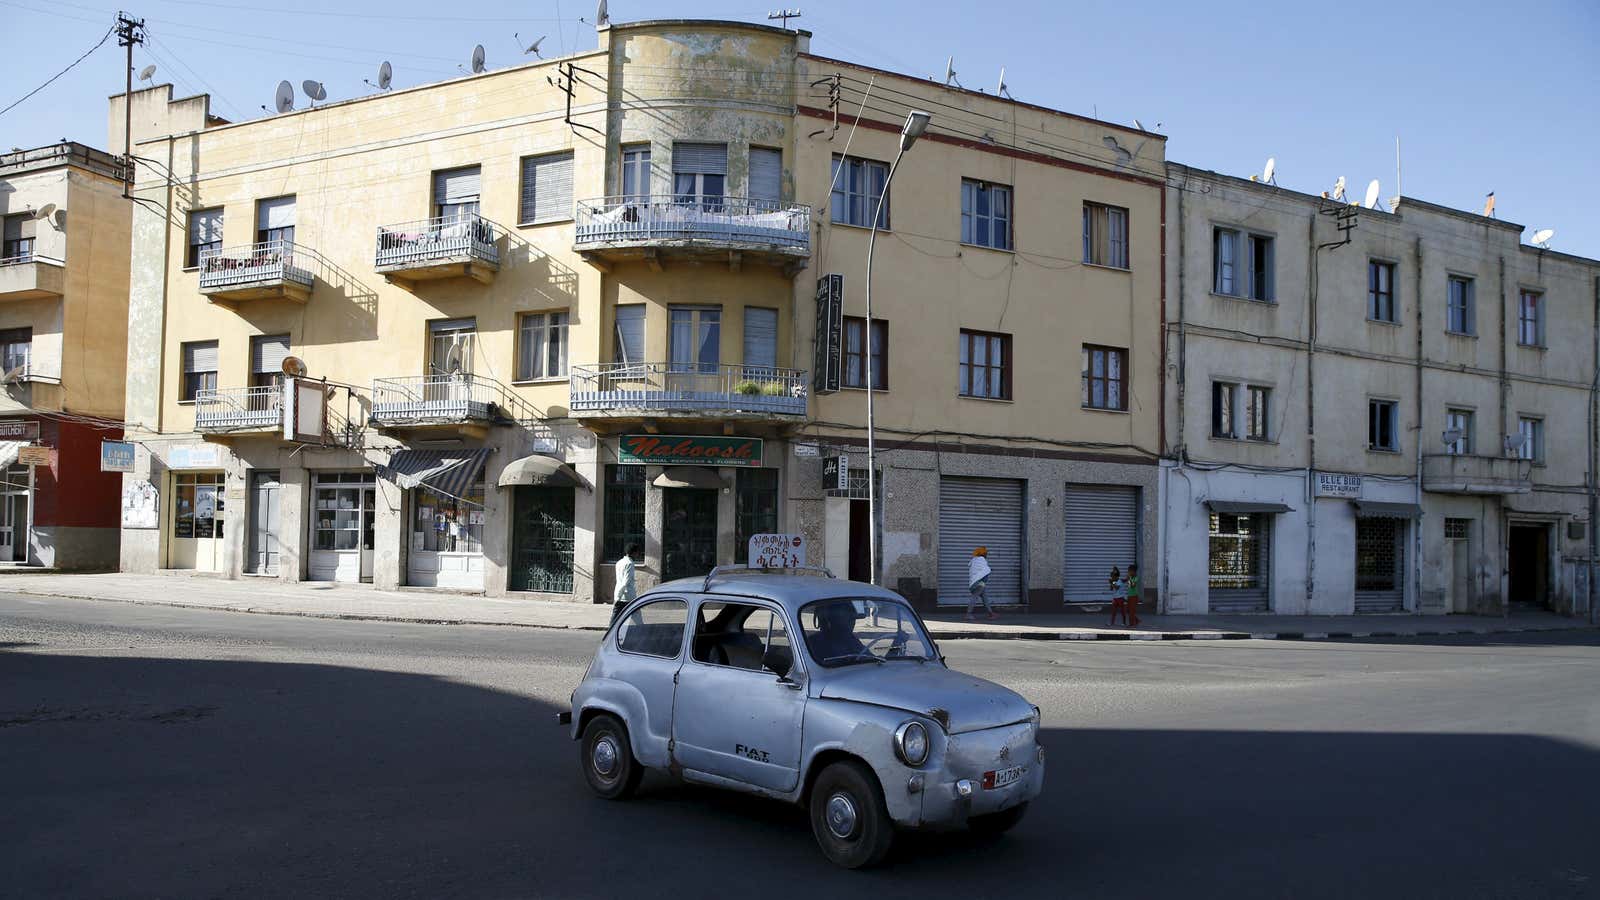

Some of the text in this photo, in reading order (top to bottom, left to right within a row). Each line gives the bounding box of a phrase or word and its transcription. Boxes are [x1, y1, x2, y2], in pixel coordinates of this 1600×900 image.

[1321, 475, 1360, 486] BLUE BIRD
[1322, 484, 1360, 492] RESTAURANT
[736, 744, 769, 757] FIAT
